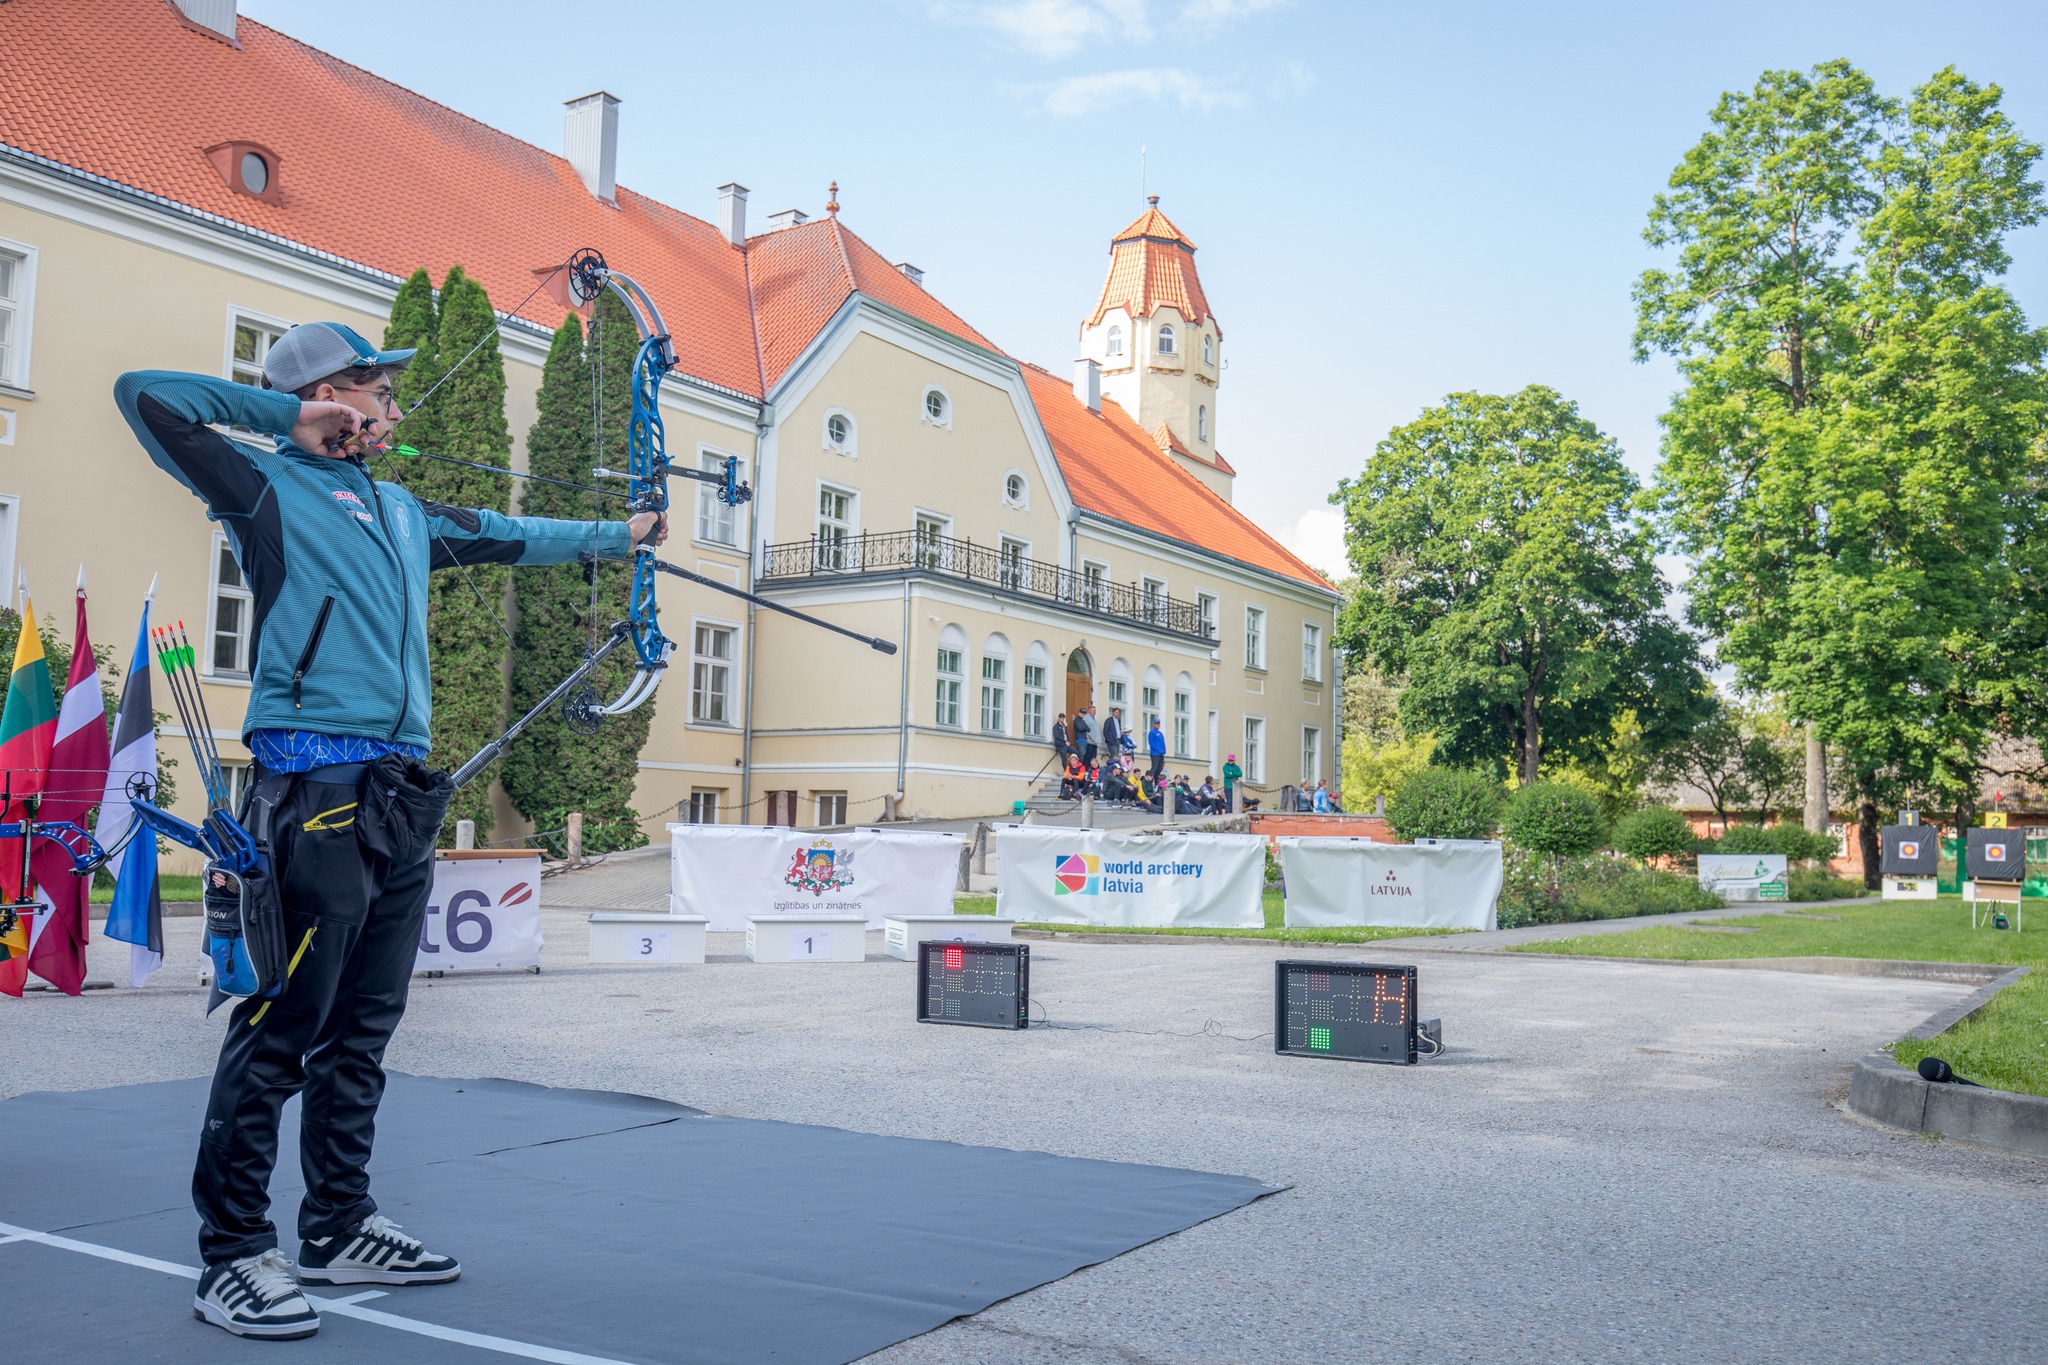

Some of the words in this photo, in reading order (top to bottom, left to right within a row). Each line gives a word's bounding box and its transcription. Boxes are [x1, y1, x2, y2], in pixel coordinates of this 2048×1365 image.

[1905, 812, 1913, 827] 1
[1991, 815, 2001, 828] 2
[1104, 861, 1143, 875] world
[1147, 861, 1203, 878] archery
[1103, 877, 1144, 893] latvia
[1371, 885, 1412, 897] LATVIJA
[812, 902, 824, 910] un
[826, 901, 862, 910] zinātnes
[640, 937, 653, 955] 3
[804, 937, 813, 954] 1
